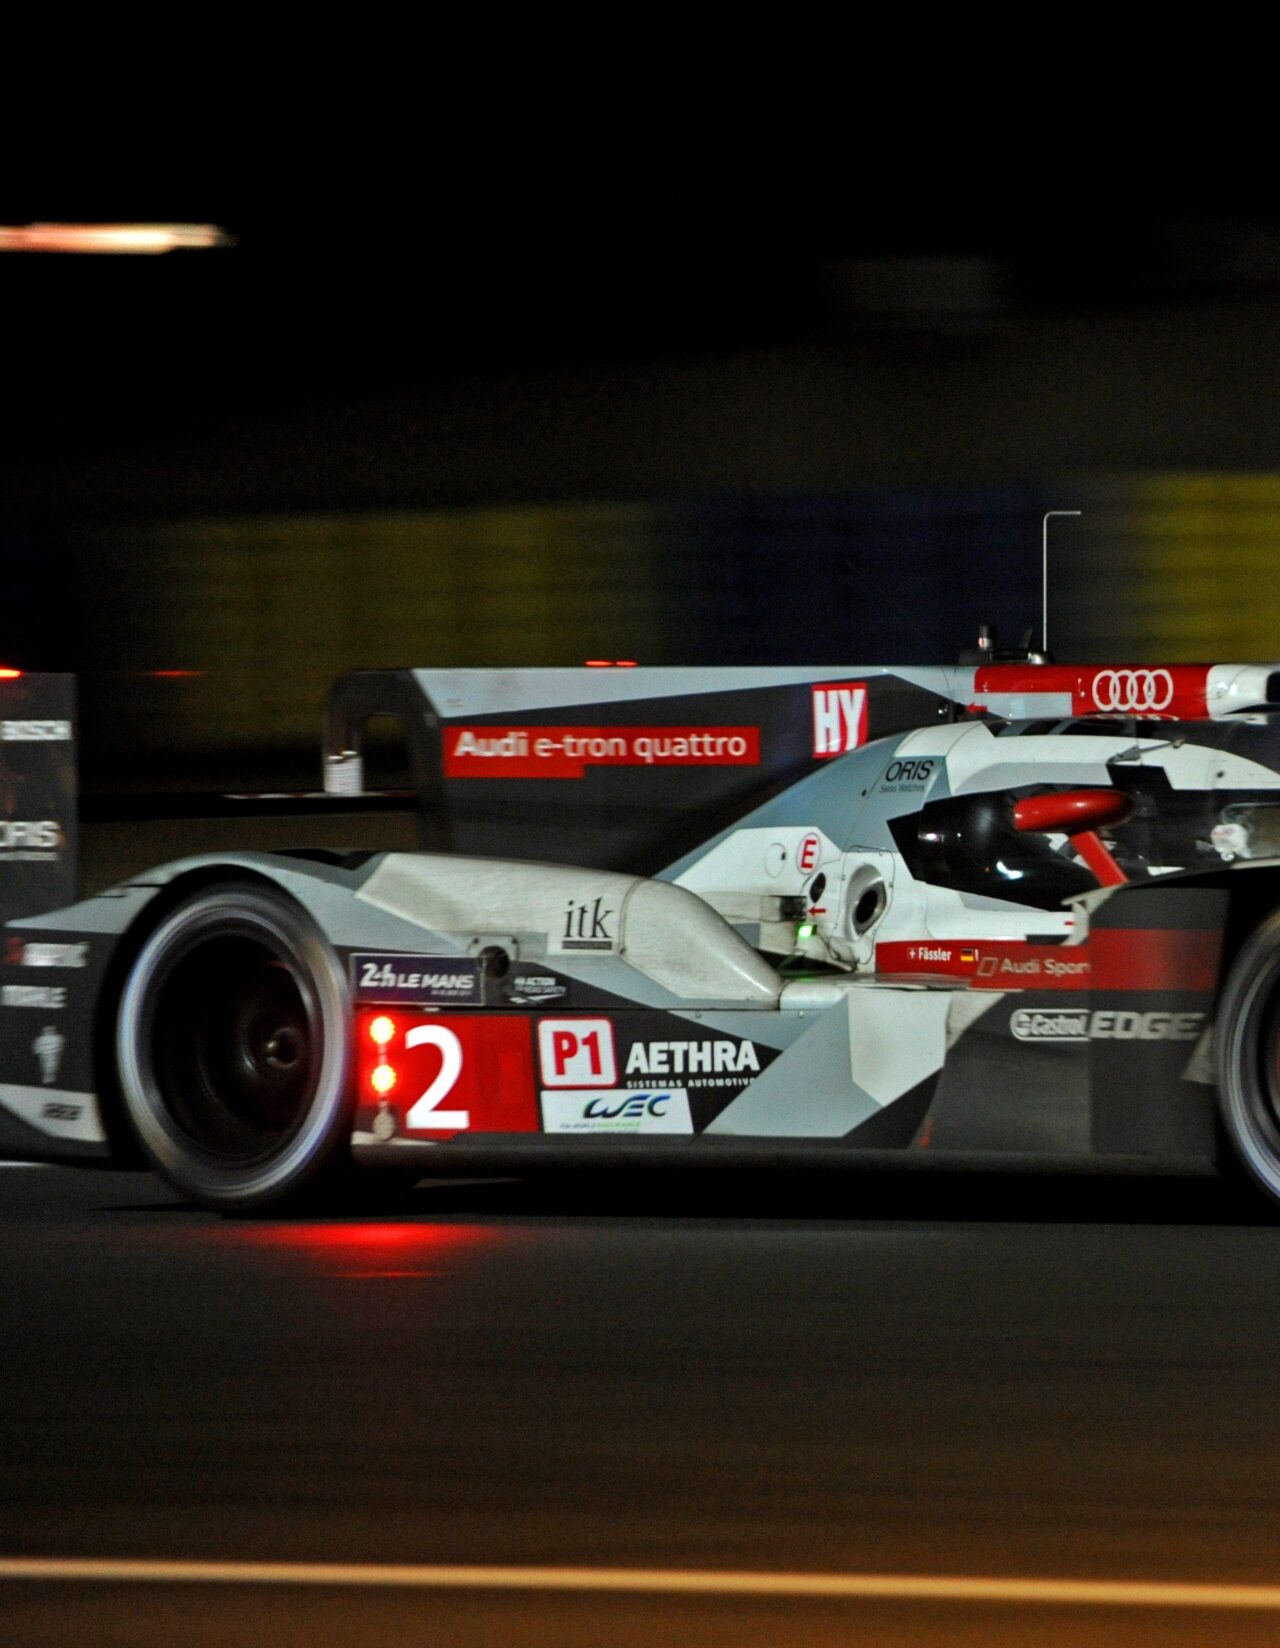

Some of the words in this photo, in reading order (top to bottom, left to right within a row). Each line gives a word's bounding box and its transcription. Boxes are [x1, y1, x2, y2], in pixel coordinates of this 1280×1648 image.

[813, 688, 866, 753] HY
[454, 732, 529, 757] Audi
[533, 734, 626, 757] e-tron
[633, 736, 748, 763] quattro
[886, 760, 934, 782] ORIS
[801, 840, 816, 868] E
[564, 896, 613, 938] itk
[918, 948, 952, 961] Fässler
[1001, 959, 1040, 974] Audi
[397, 974, 420, 988] LE
[421, 974, 475, 989] MANS
[1089, 1011, 1206, 1040] EDGE
[552, 1031, 602, 1076] P1
[625, 1040, 761, 1075] AETHRA
[405, 1024, 470, 1129] 2
[626, 1079, 683, 1089] SISTEMAS
[584, 1094, 671, 1119] WEC
